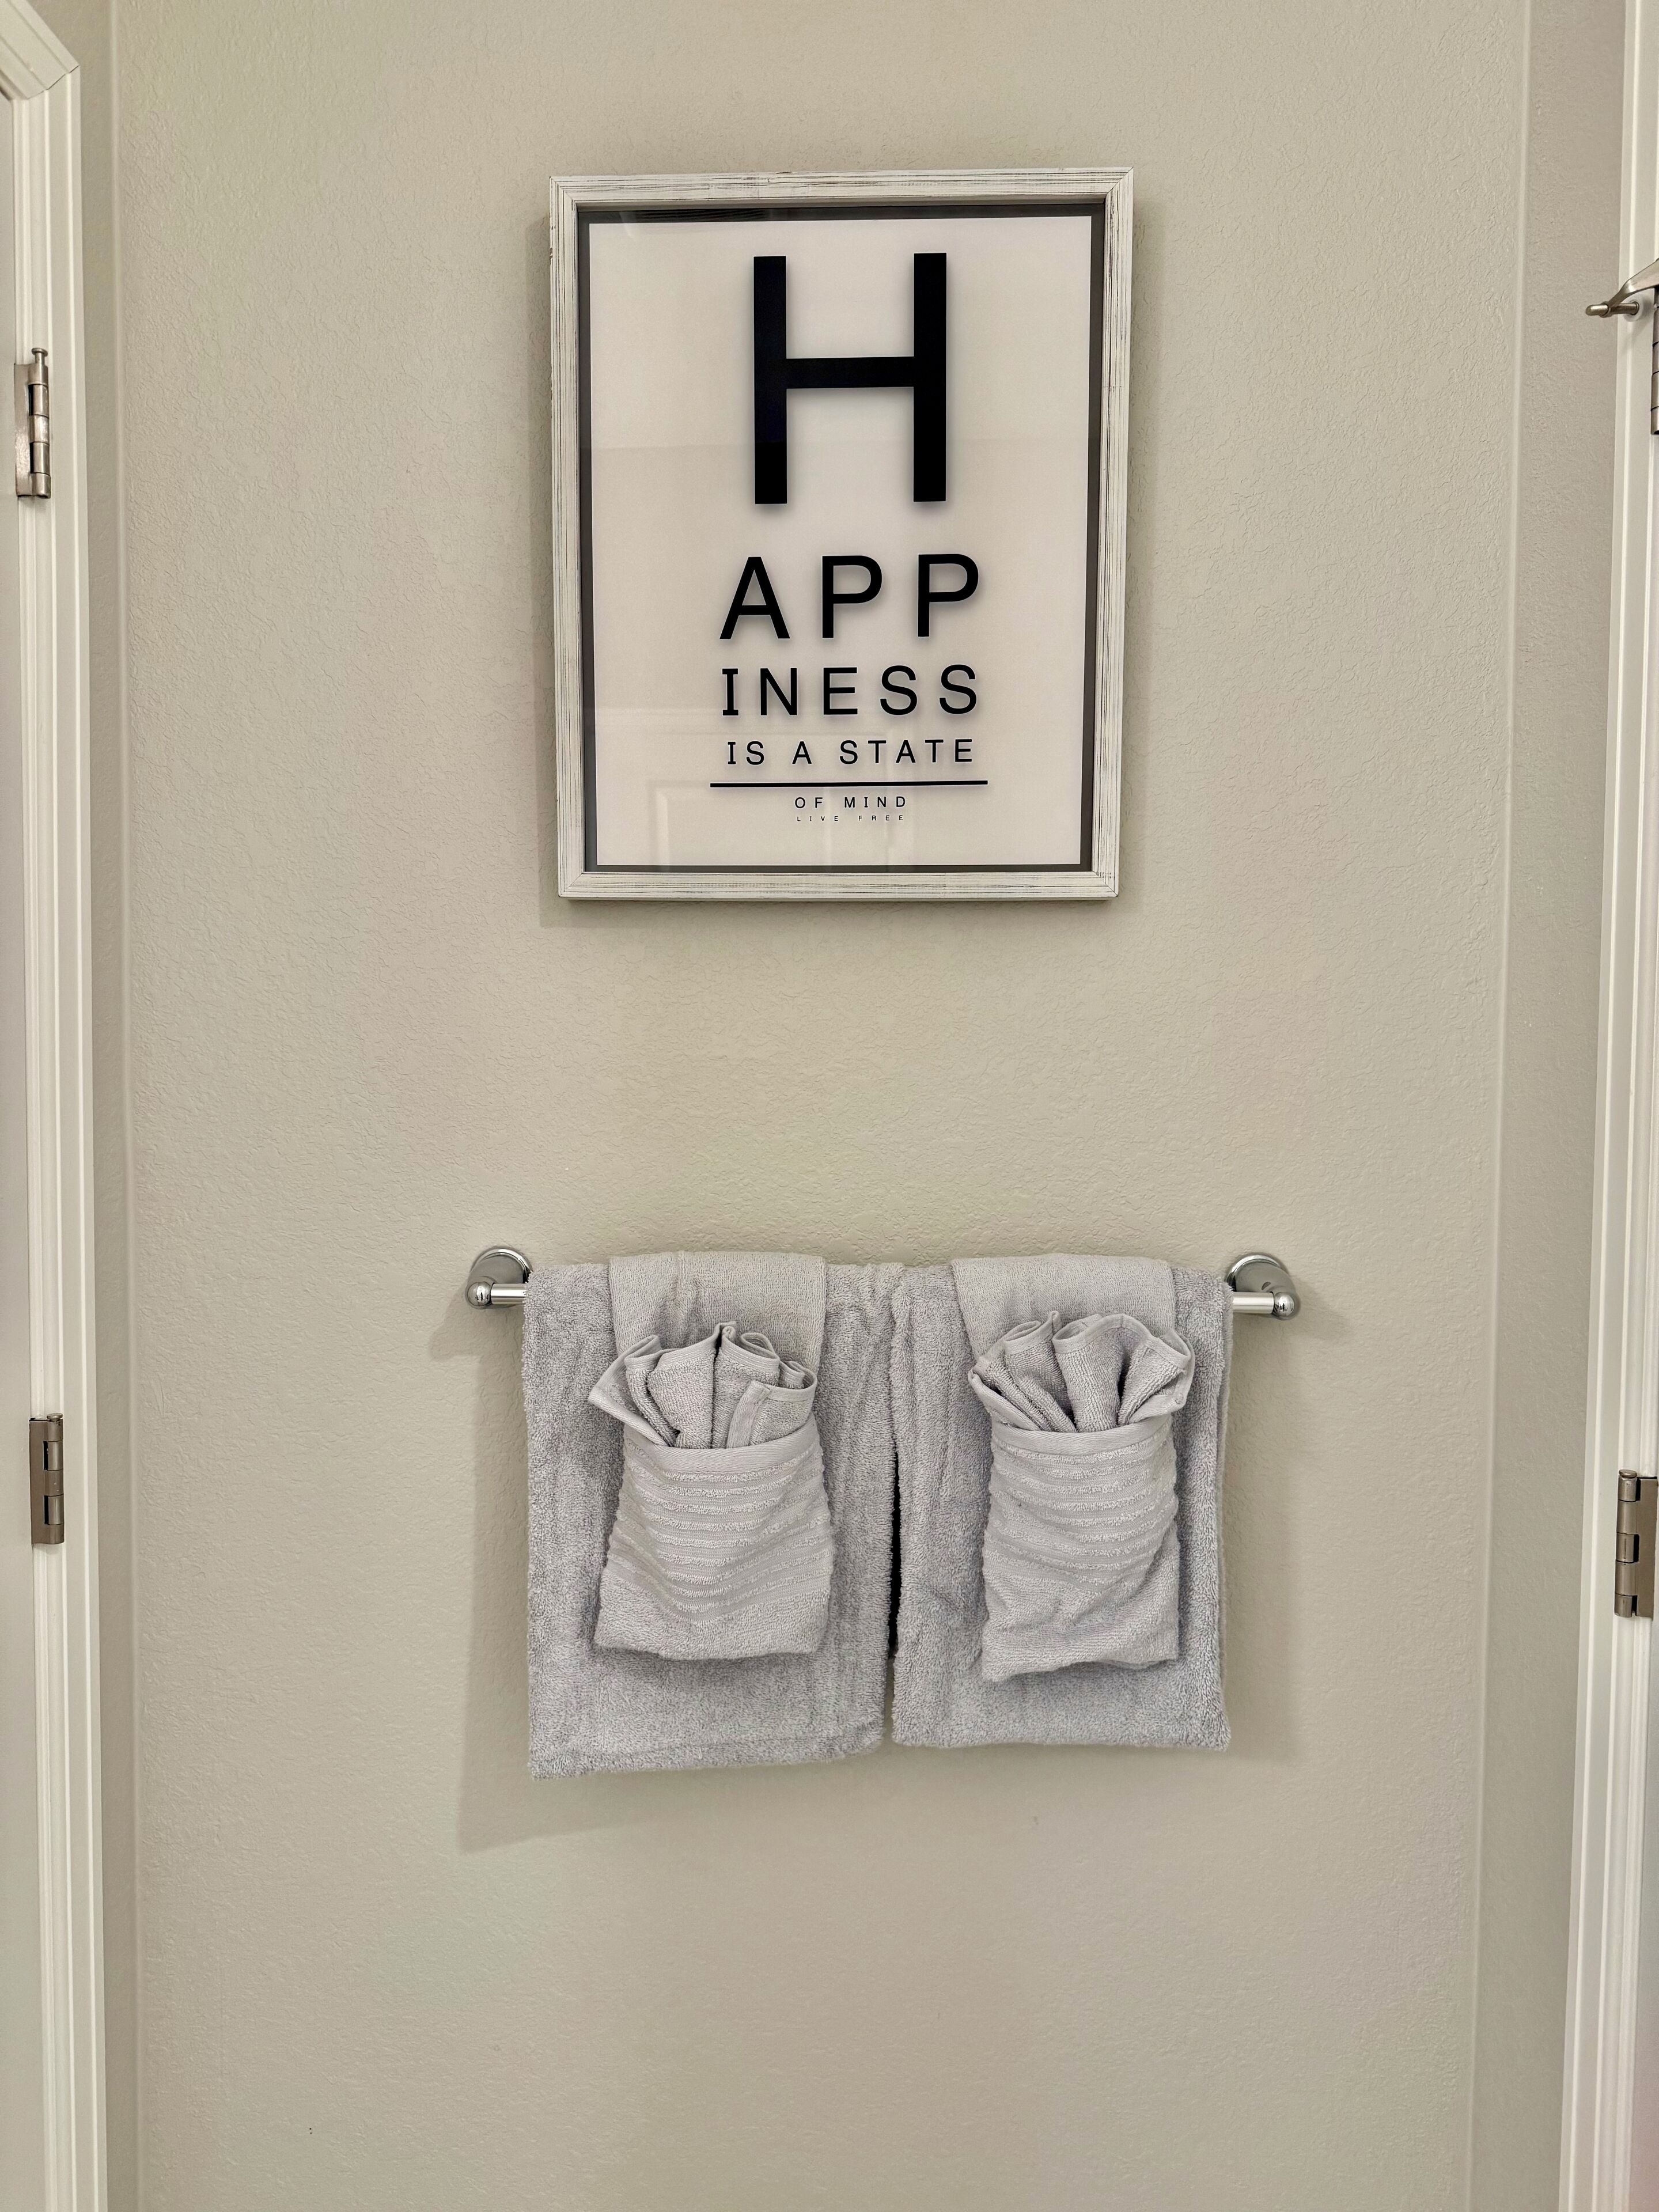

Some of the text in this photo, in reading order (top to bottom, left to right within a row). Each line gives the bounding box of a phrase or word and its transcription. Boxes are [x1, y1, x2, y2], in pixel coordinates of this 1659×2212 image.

[753, 252, 947, 505] H
[719, 553, 979, 639] APP
[722, 664, 977, 716] INESS
[727, 738, 972, 766] IS A STATE
[794, 795, 906, 809] OF MIND
